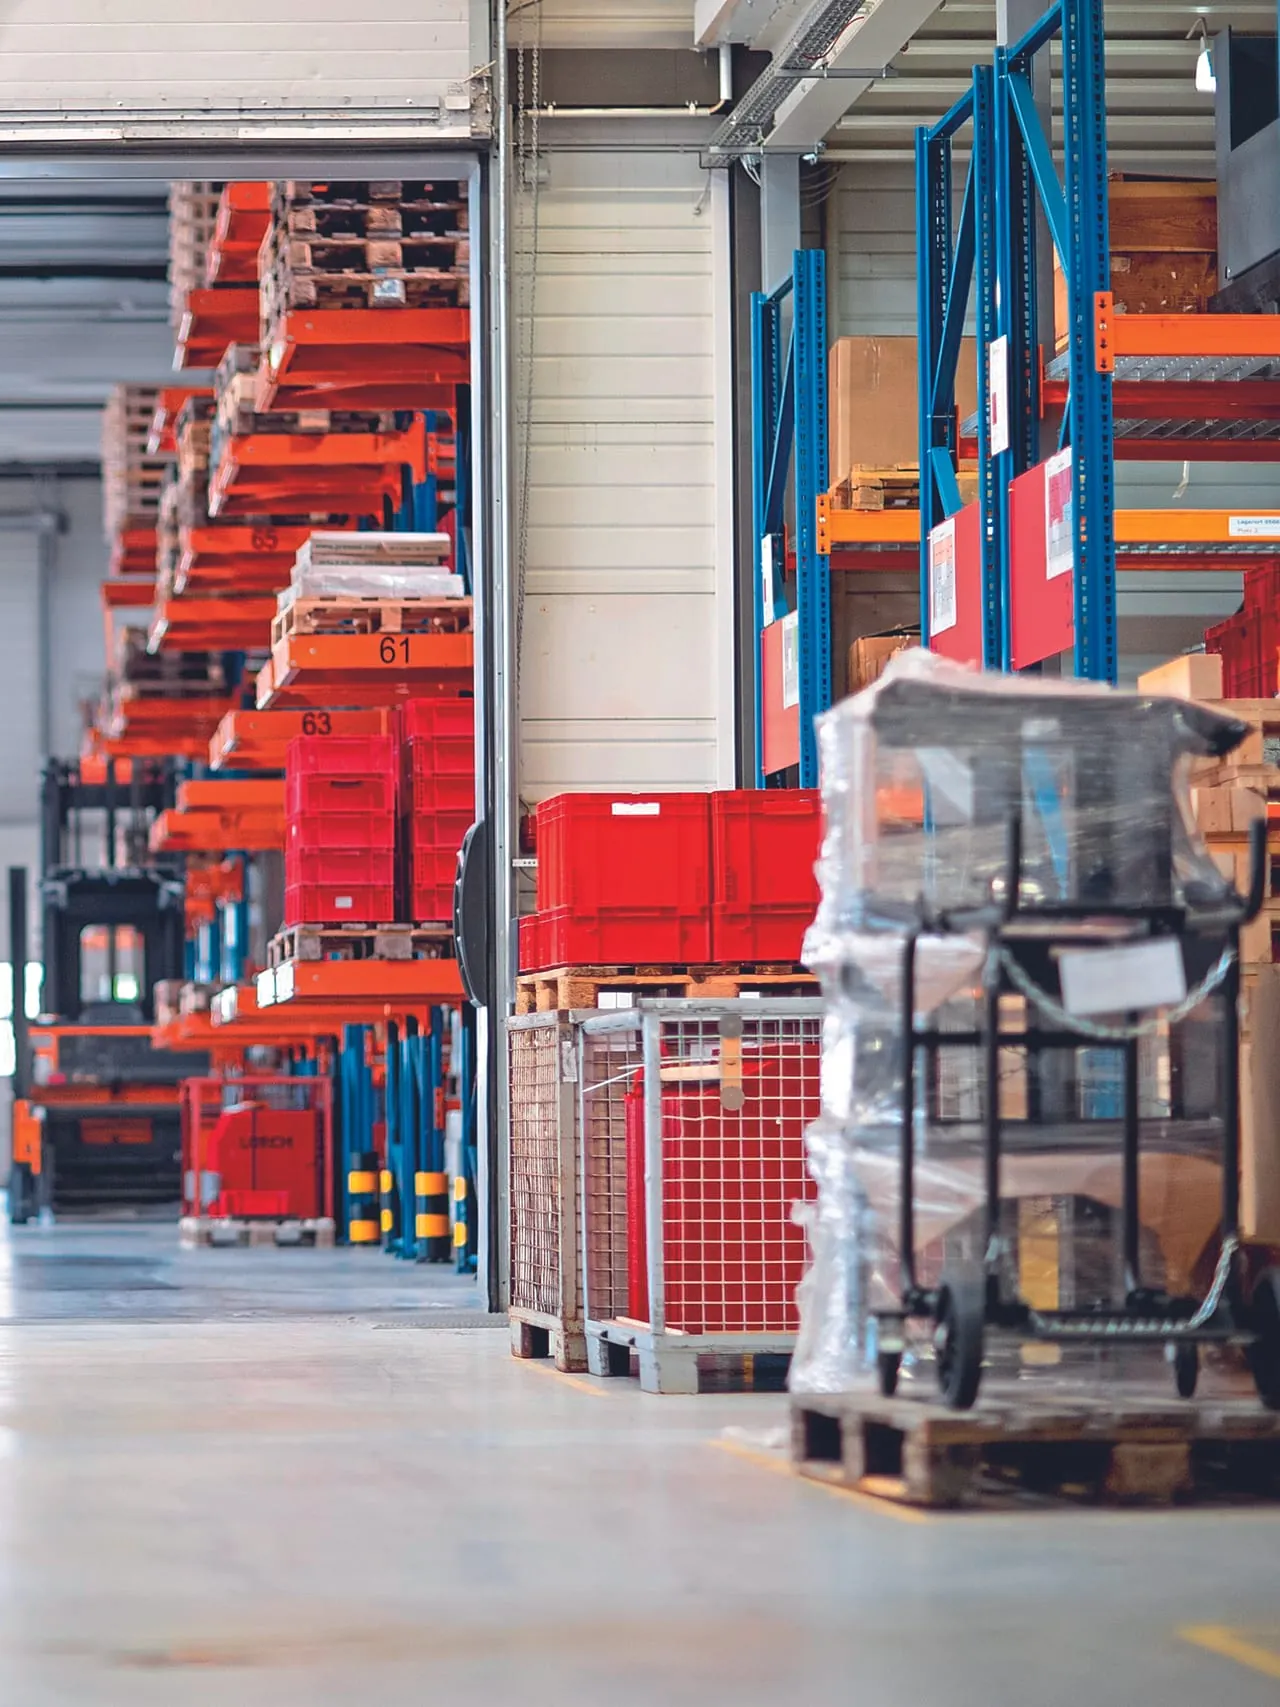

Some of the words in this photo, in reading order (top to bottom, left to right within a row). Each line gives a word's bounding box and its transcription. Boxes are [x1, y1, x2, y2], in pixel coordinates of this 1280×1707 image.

[251, 526, 279, 551] 65
[380, 636, 410, 664] 61
[302, 712, 332, 735] 63
